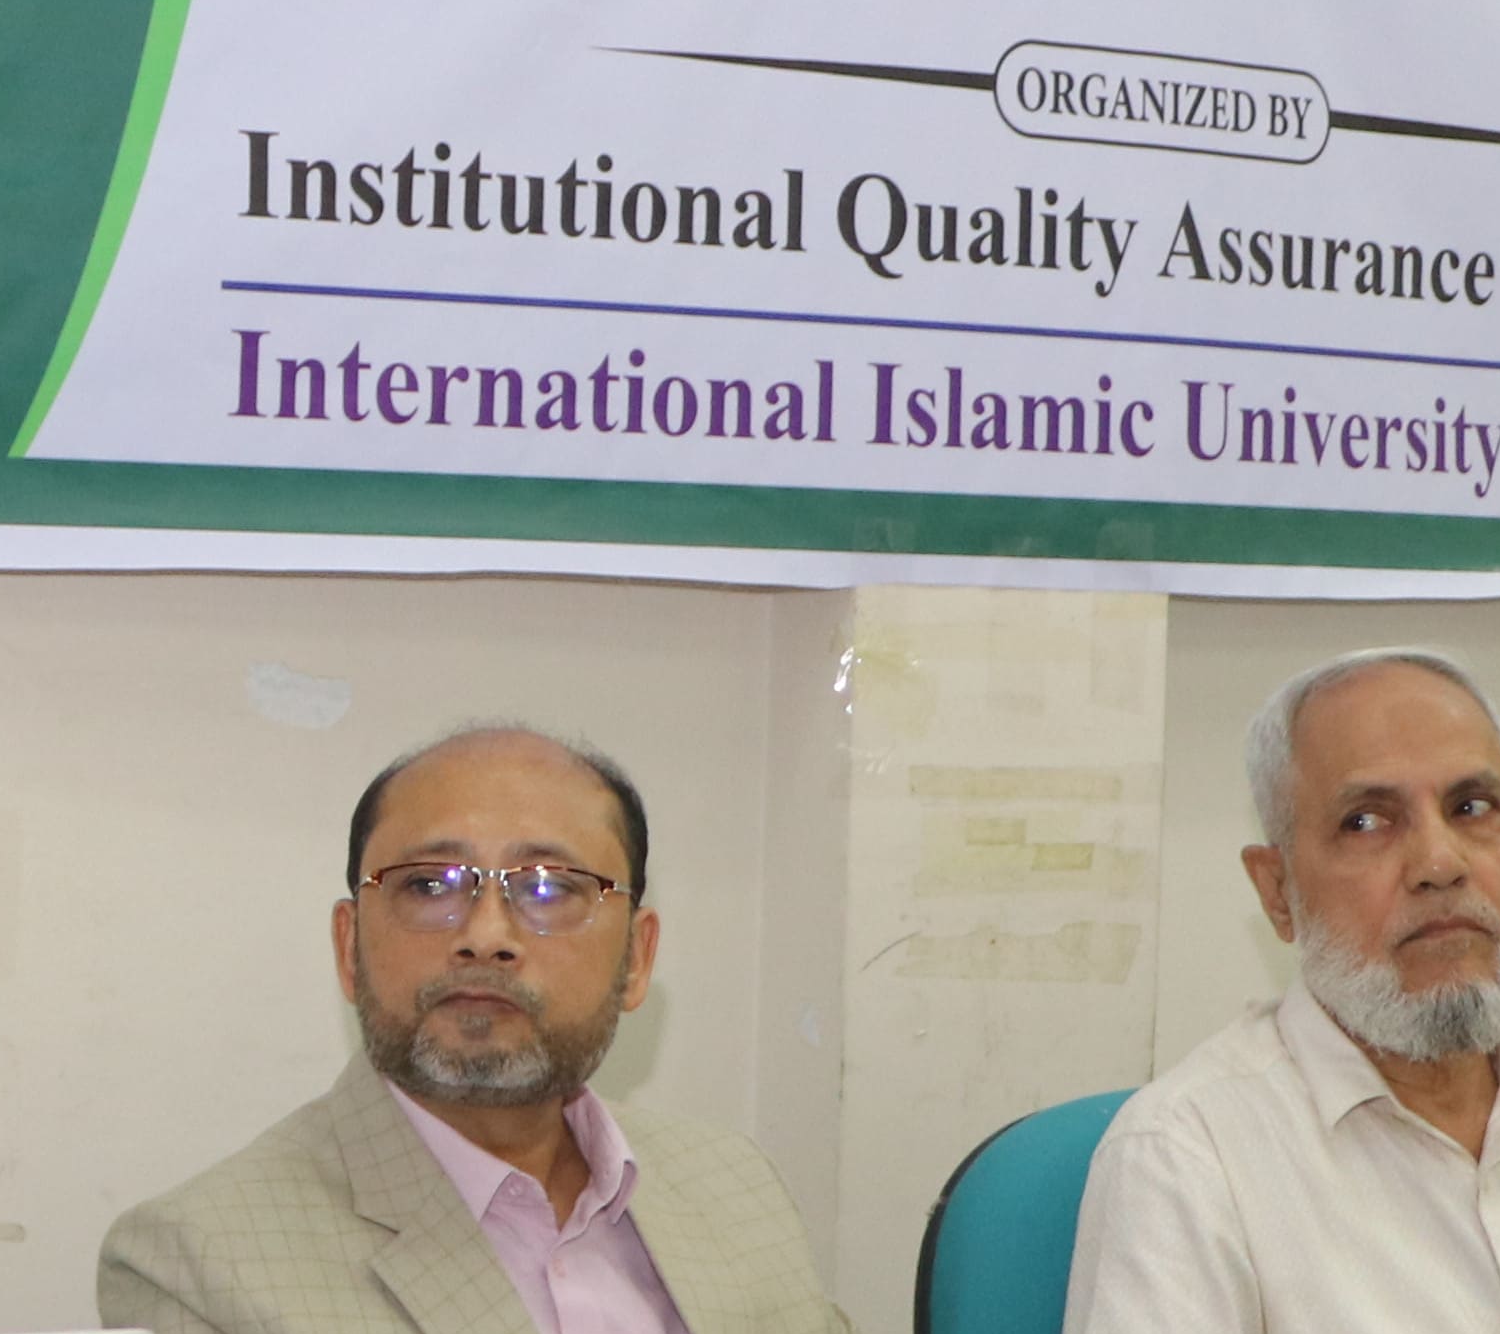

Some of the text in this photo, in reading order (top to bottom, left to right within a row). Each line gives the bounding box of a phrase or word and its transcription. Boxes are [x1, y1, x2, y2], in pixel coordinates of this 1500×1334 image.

[1016, 64, 1314, 142] ORGANIZED BY
[238, 129, 807, 253] Institutional
[837, 171, 1138, 298] Quality
[1158, 199, 1495, 309] Assurance
[228, 326, 835, 444] International
[864, 361, 1156, 457] Islamic
